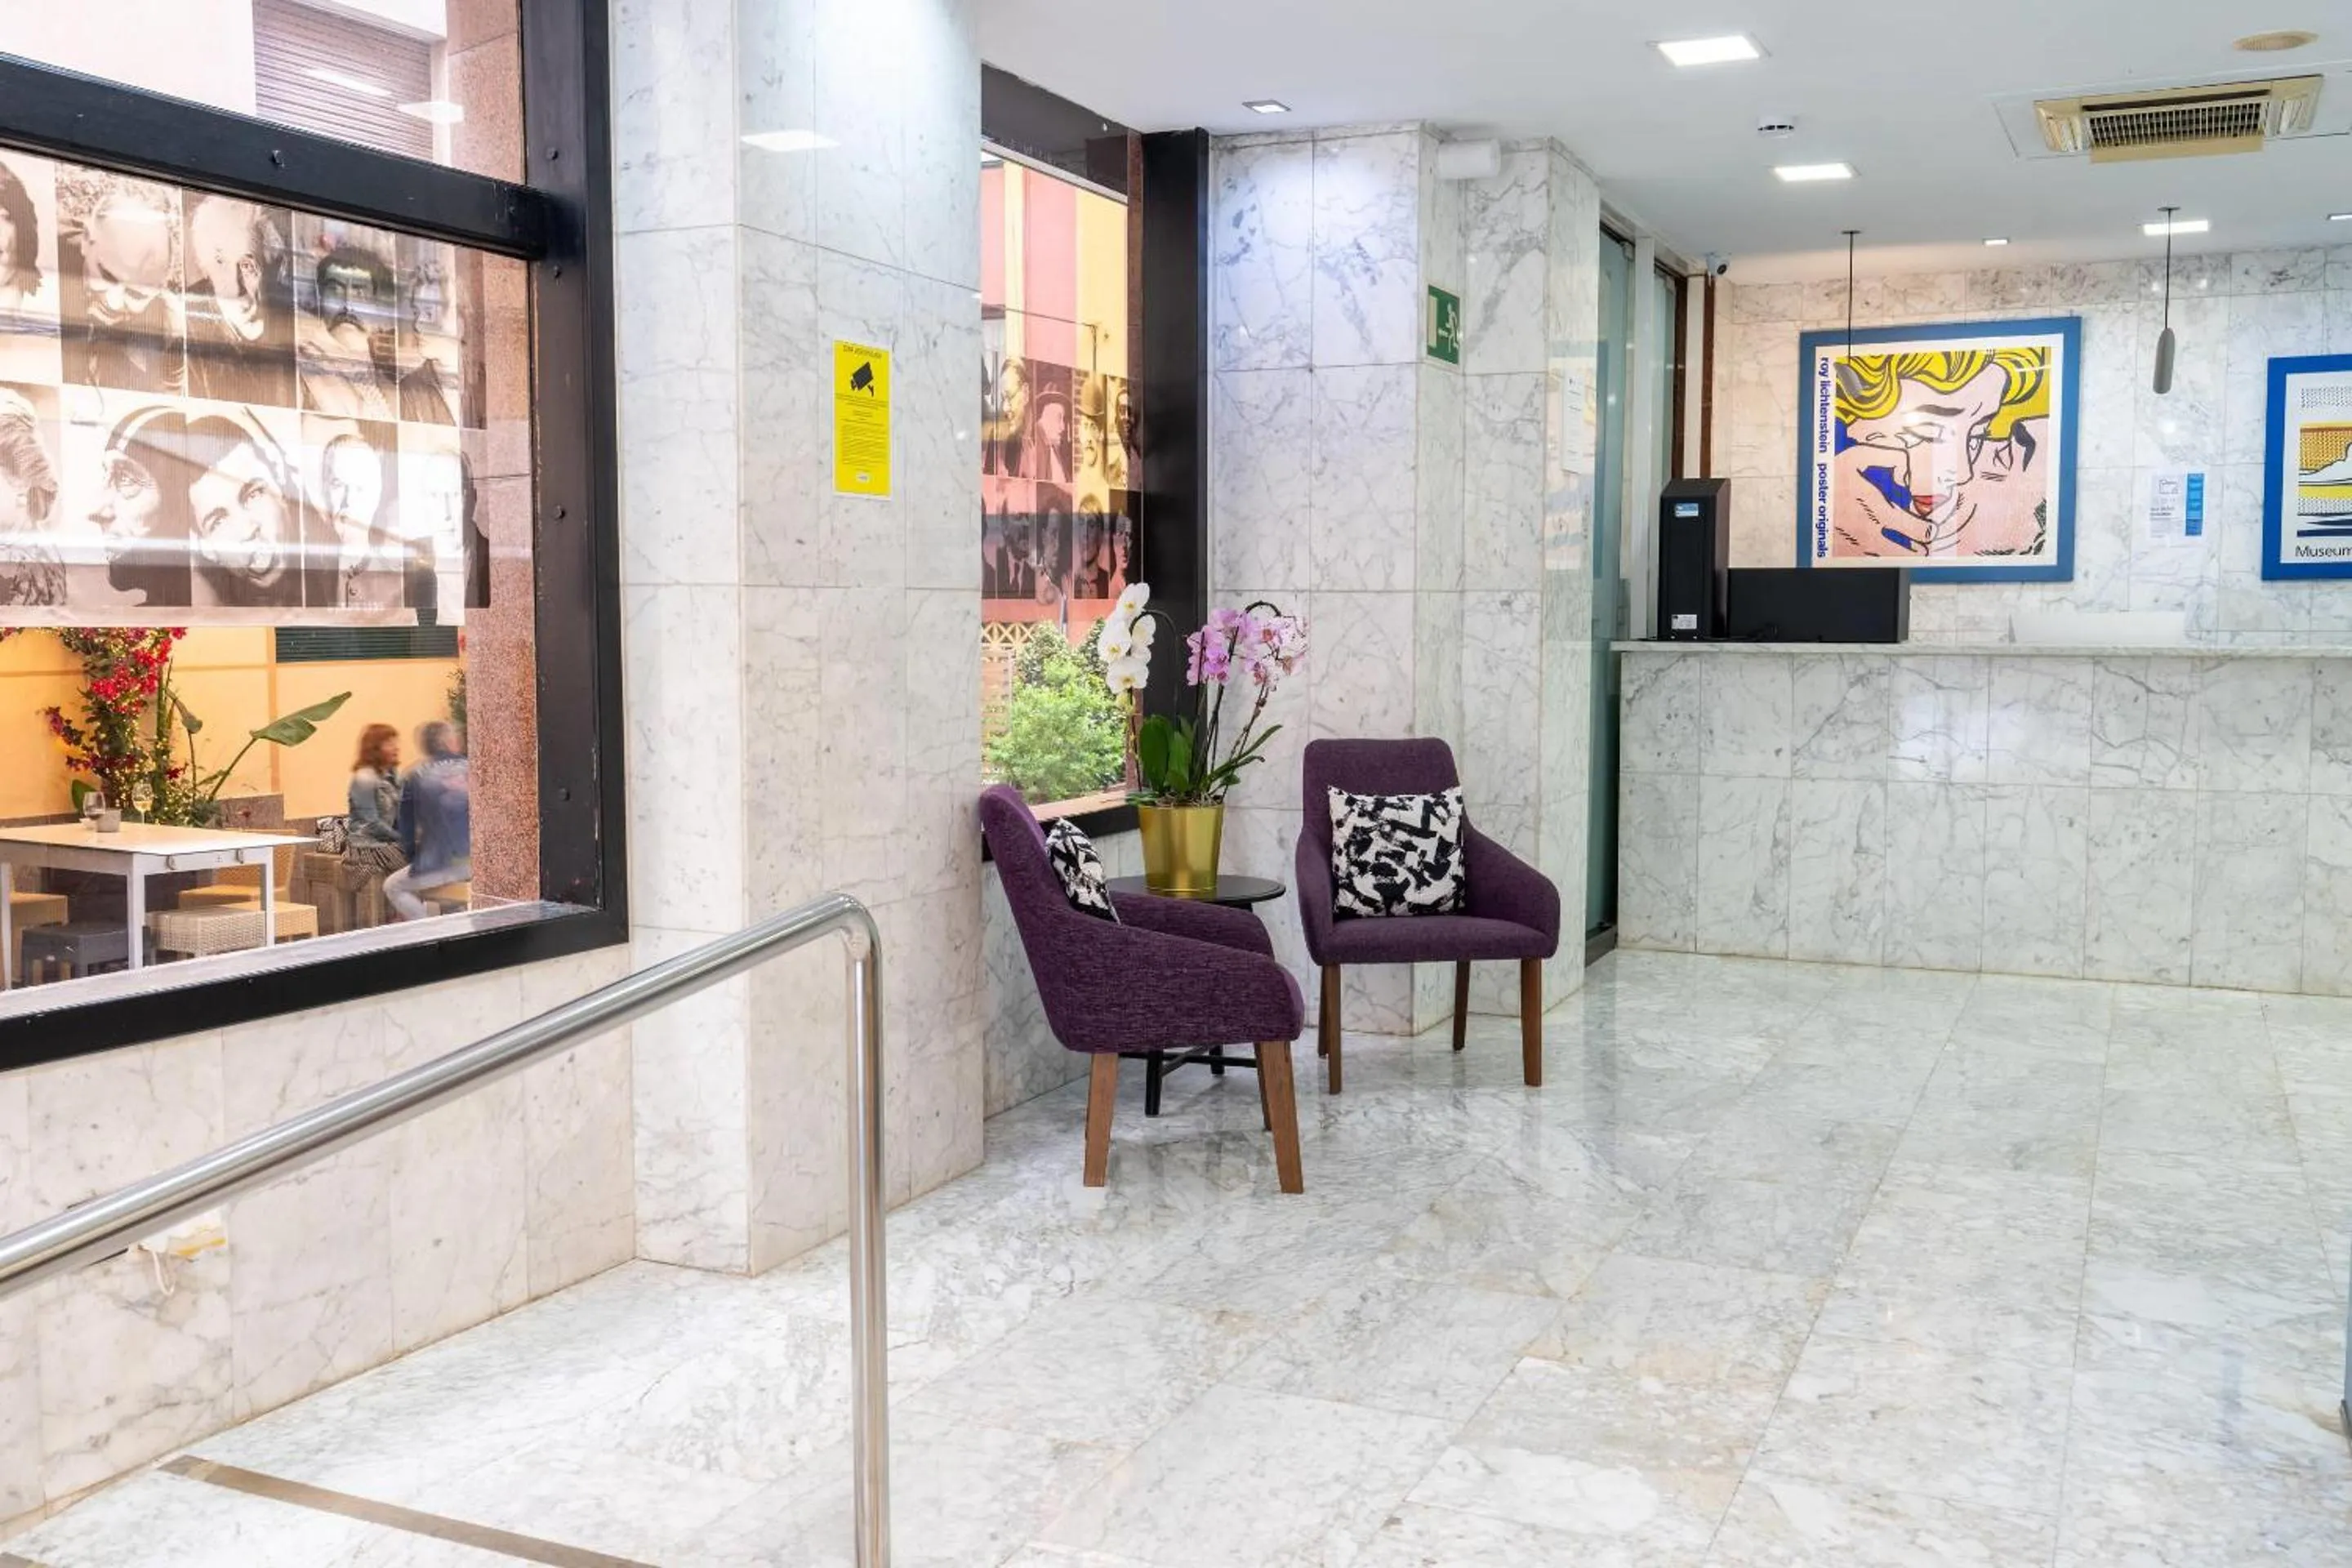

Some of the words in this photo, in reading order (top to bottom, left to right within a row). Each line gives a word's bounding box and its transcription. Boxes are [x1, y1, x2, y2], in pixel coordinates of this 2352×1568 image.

[1819, 357, 1829, 377] roy
[1819, 380, 1831, 453] lichtenstein
[1816, 463, 1829, 504] poster
[1815, 505, 1829, 558] originals
